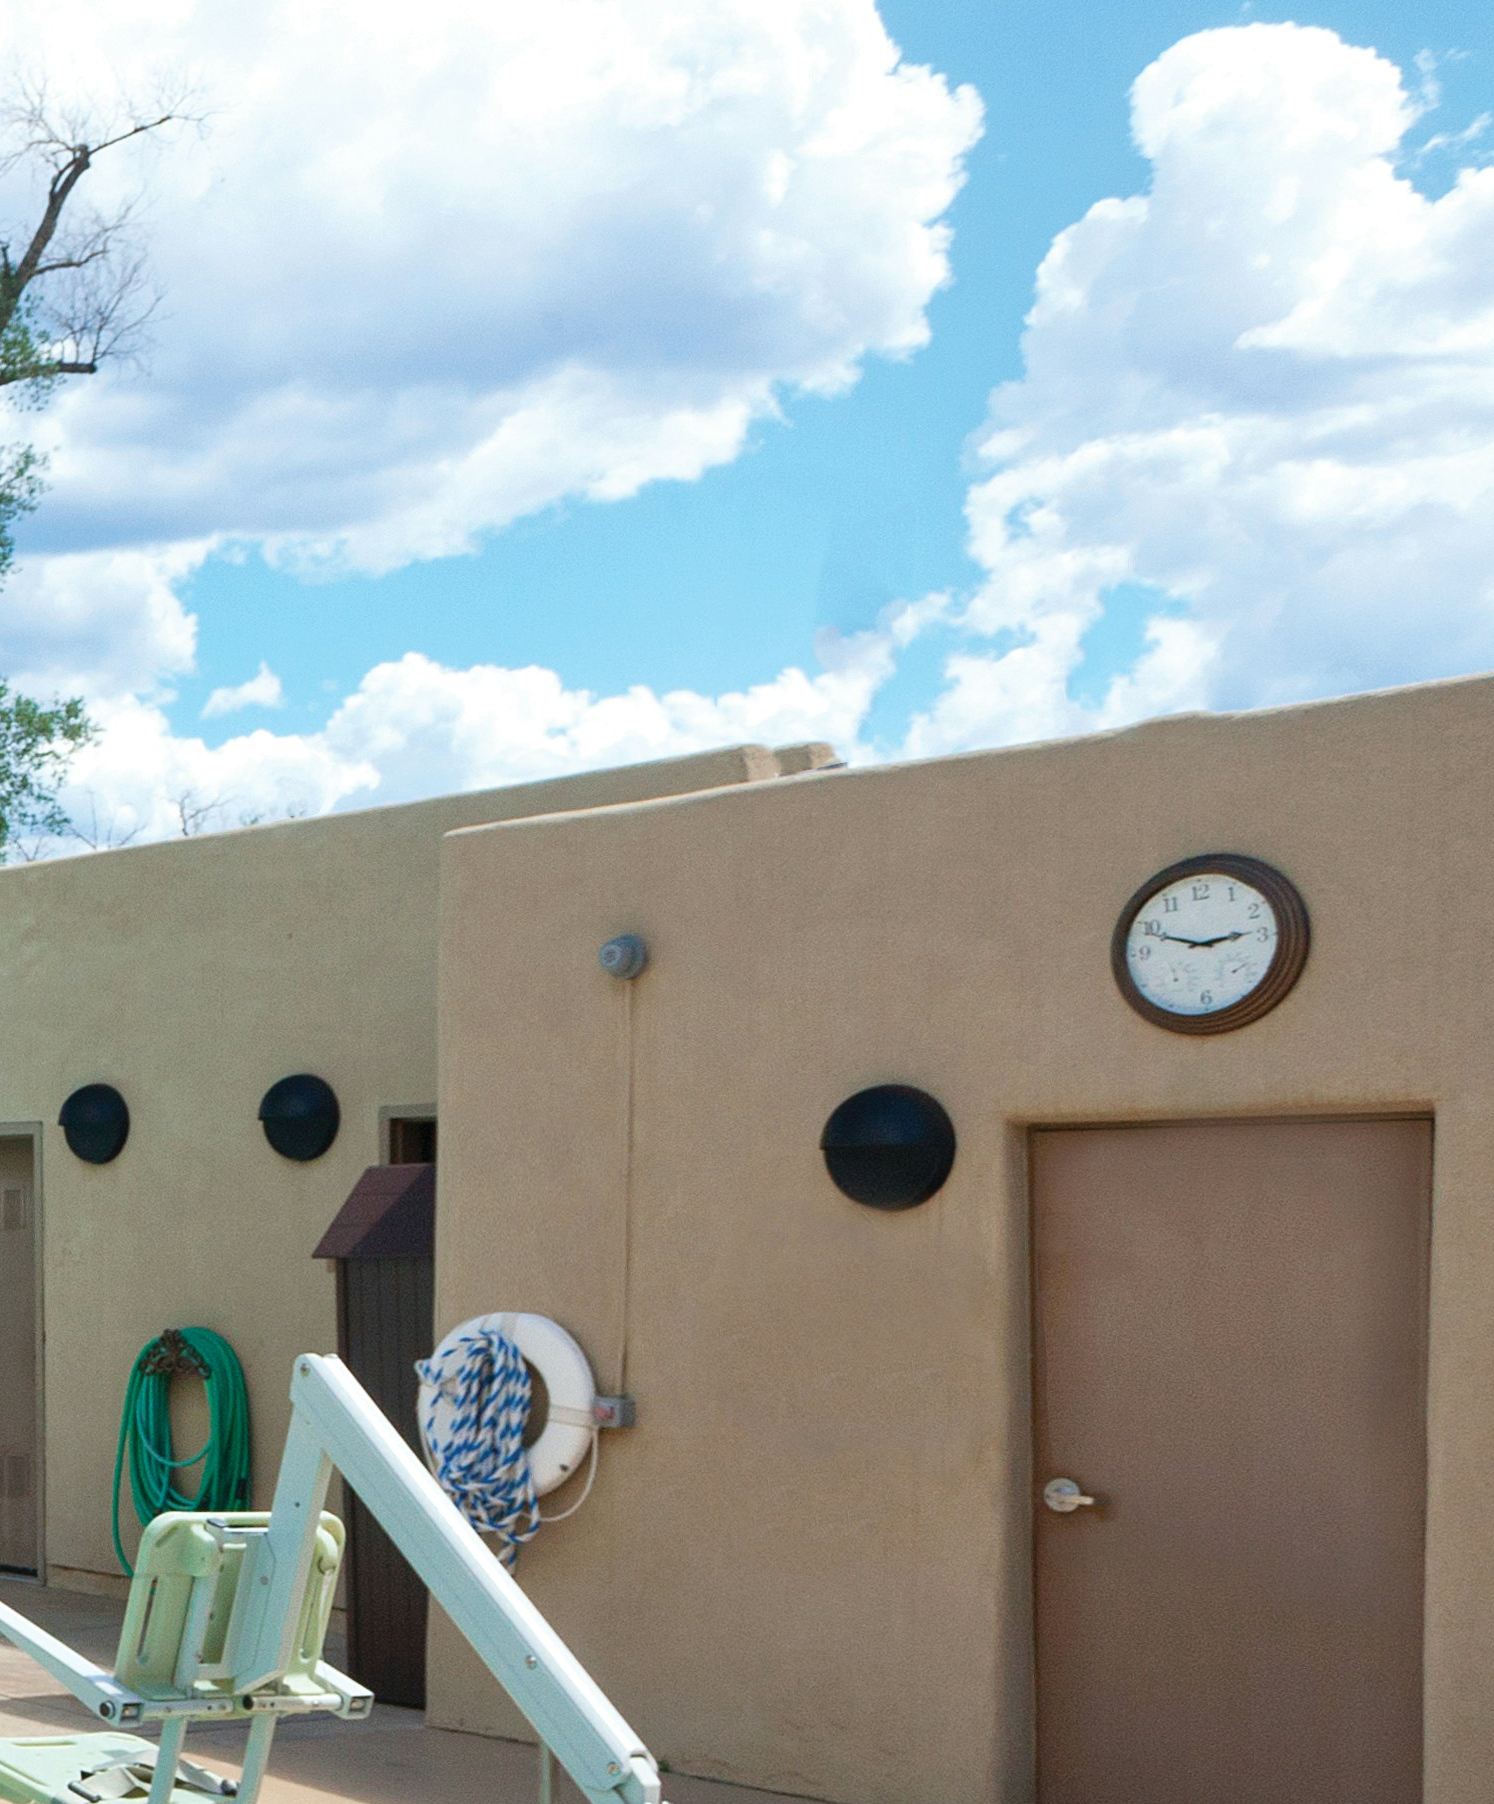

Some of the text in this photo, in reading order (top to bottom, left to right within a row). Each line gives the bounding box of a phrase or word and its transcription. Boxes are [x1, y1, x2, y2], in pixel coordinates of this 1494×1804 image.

[1191, 884, 1210, 901] 12
[1227, 887, 1235, 902] 1
[1163, 897, 1178, 913] 11
[1248, 903, 1260, 919] 2
[1144, 919, 1161, 936] 10
[1256, 926, 1269, 943] 3
[1139, 945, 1151, 960] 9
[1200, 990, 1212, 1005] 6
